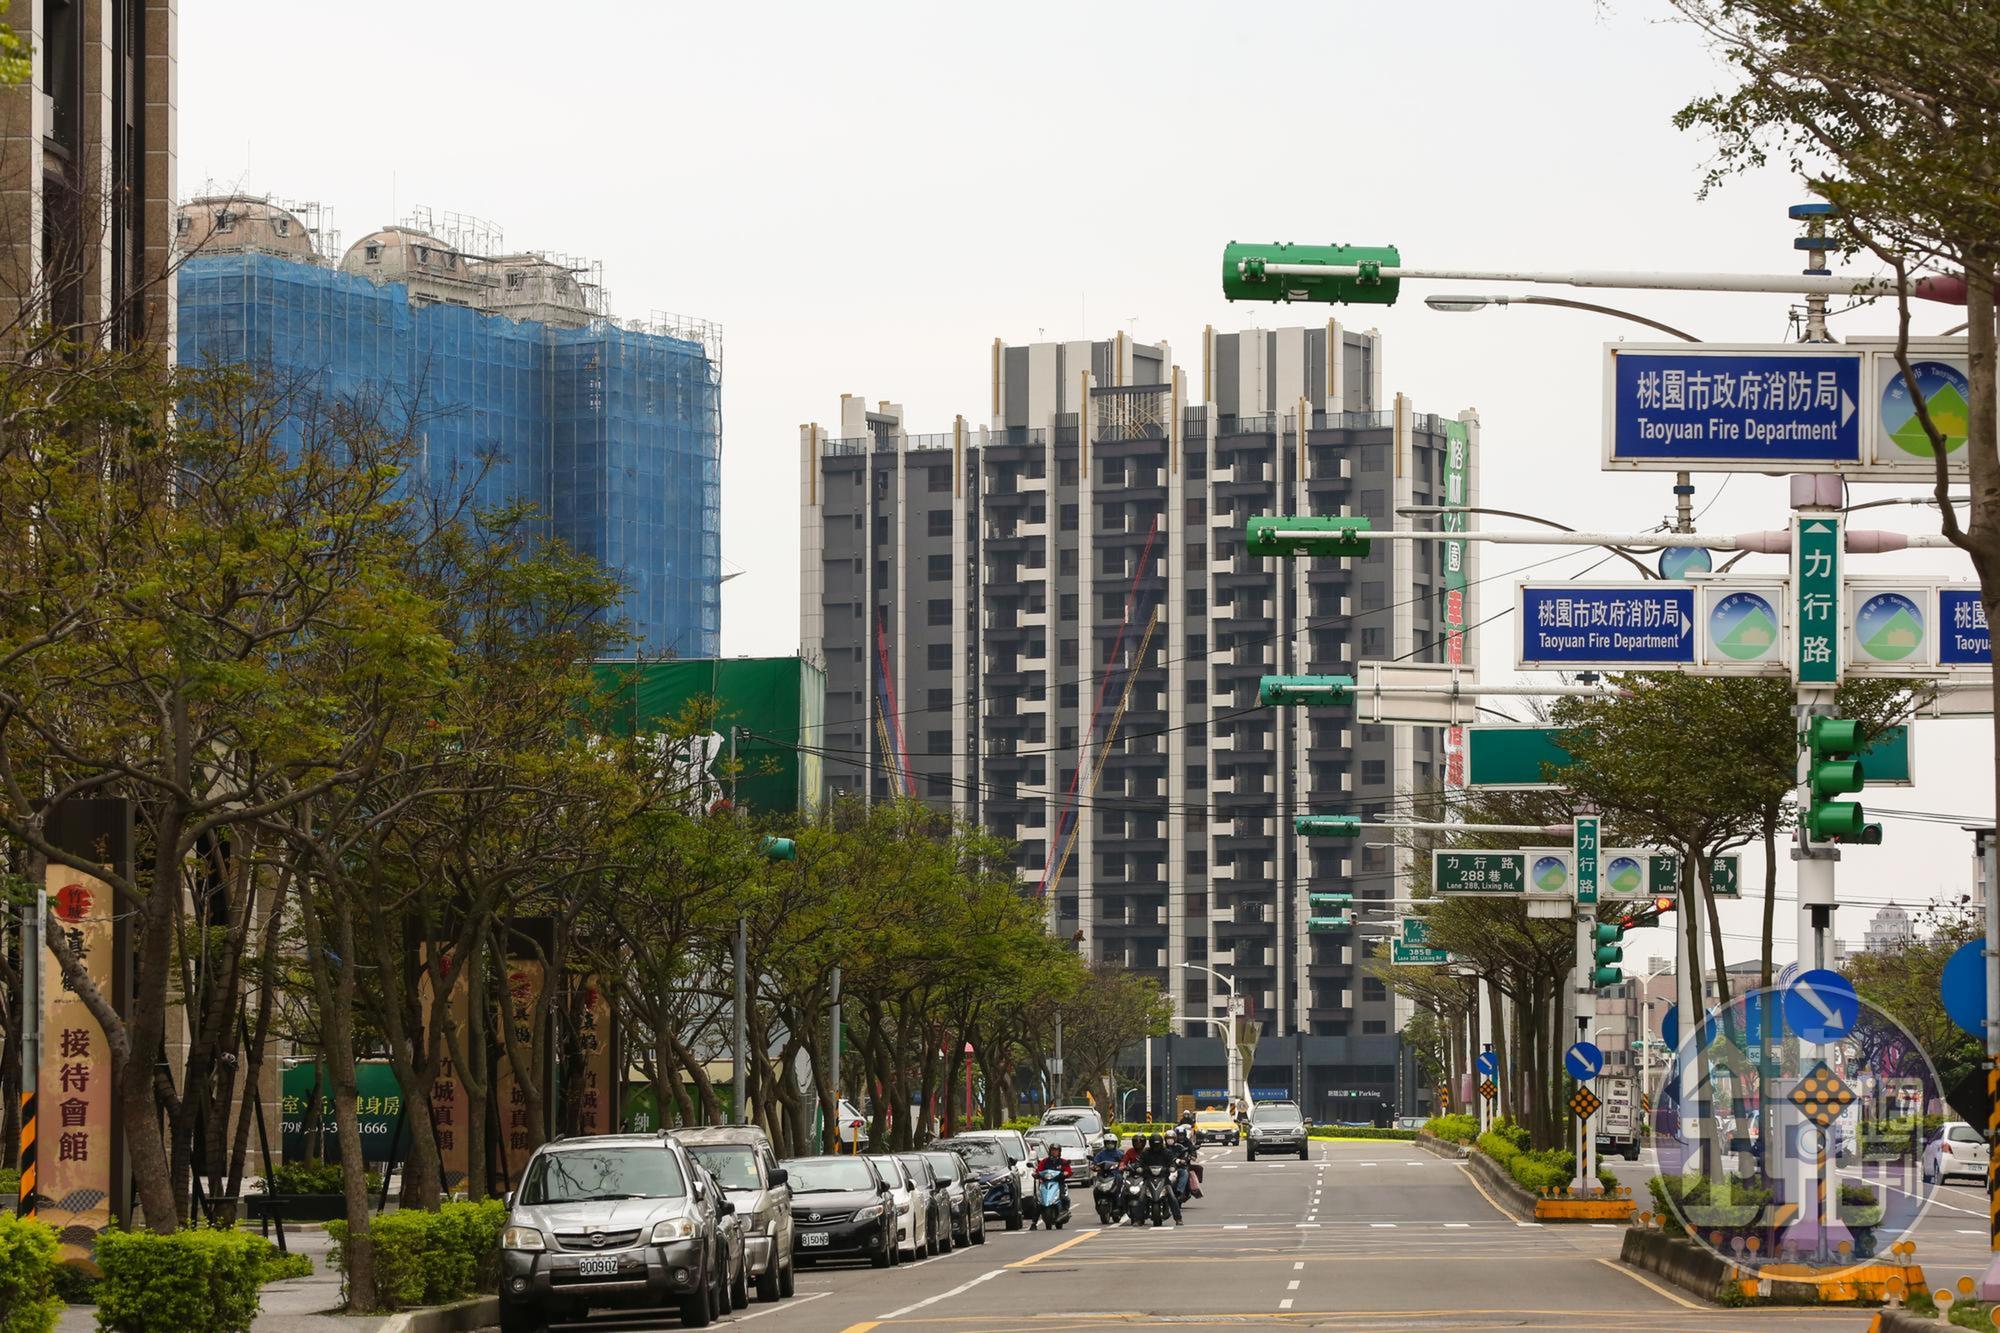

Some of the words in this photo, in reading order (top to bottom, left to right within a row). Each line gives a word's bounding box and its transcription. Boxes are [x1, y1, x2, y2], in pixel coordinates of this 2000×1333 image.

[1637, 370, 1838, 411] 桃園市政府消防局
[1638, 418, 1702, 444] Taoyuan
[1709, 418, 1739, 440] Fire
[1745, 418, 1838, 444] Department
[1538, 599, 1679, 628] 桃園市政府消防局
[1803, 549, 1832, 663] 力行路
[1539, 632, 1585, 651] Taoyuan
[1589, 632, 1610, 648] Fire
[1614, 632, 1679, 651] Department
[1461, 870, 1485, 881] 288
[1488, 870, 1501, 882] 巷
[1580, 834, 1595, 893] 力行路
[1482, 882, 1502, 890] Lixing
[59, 1028, 90, 1162] 接待會館
